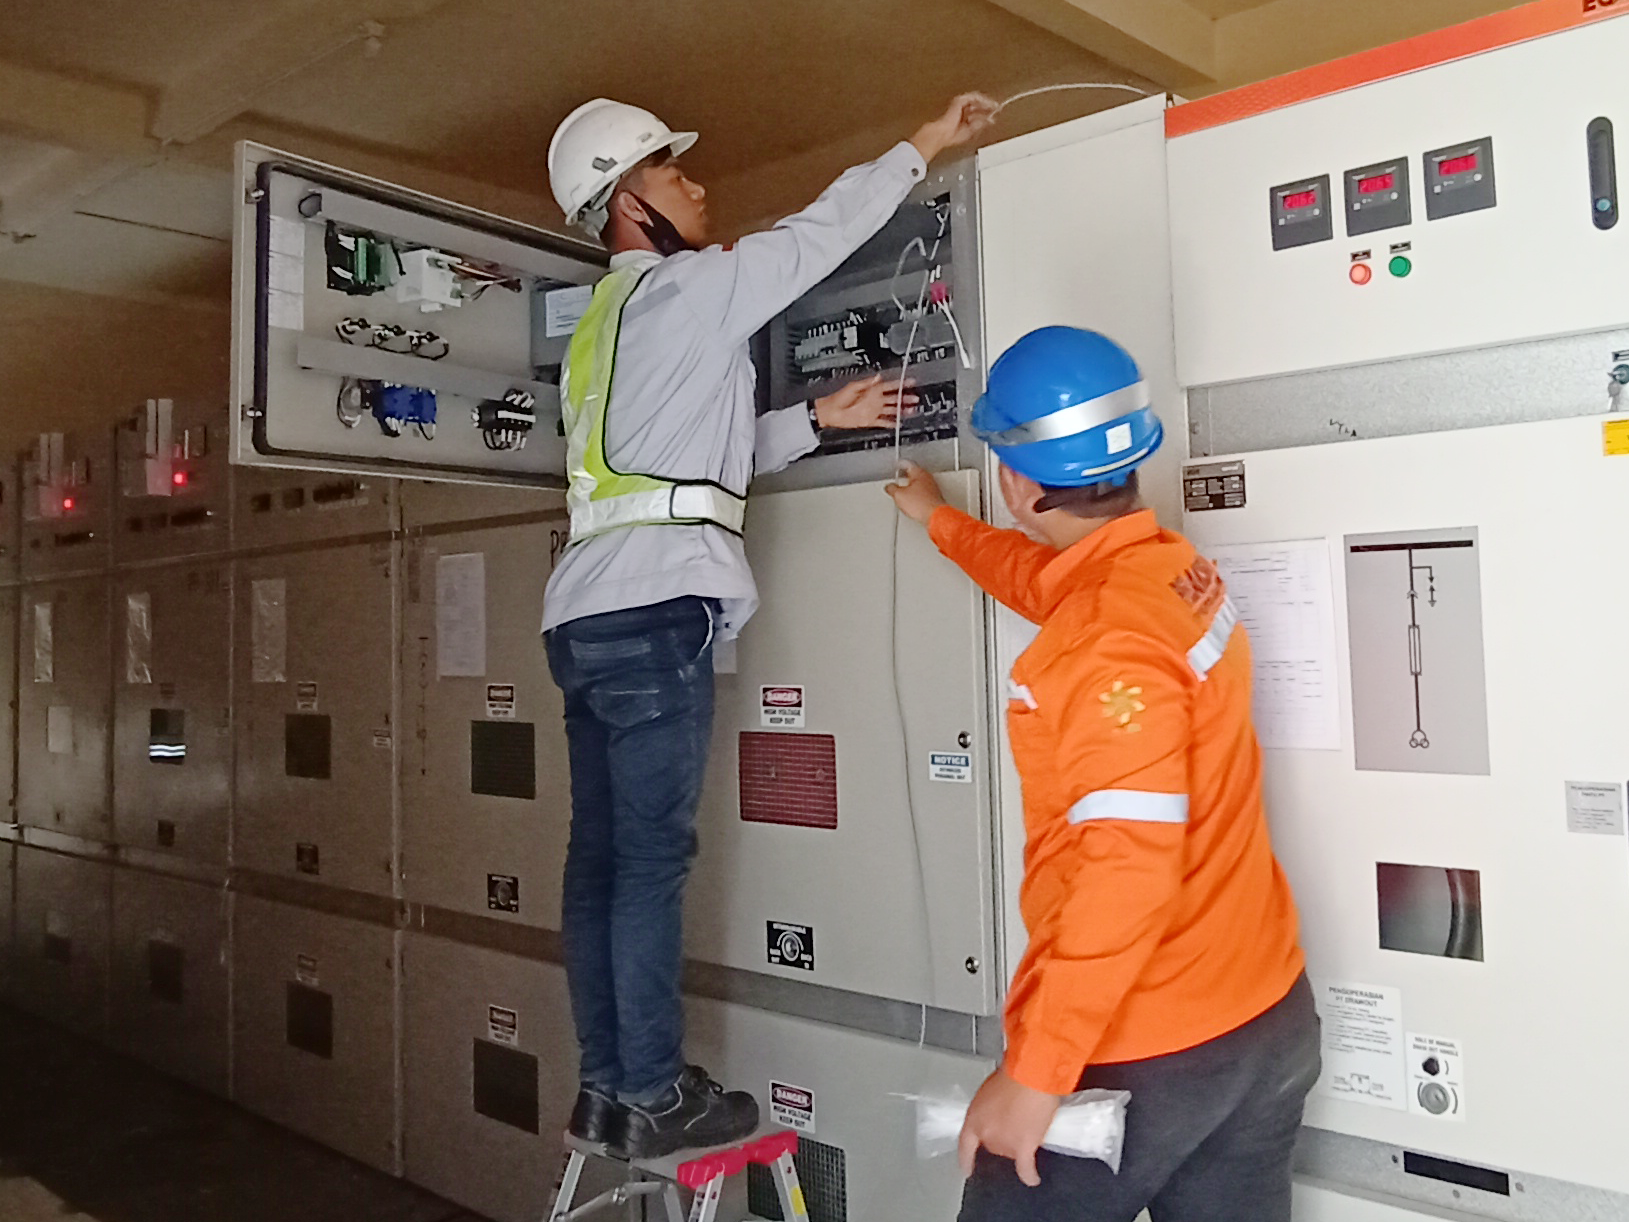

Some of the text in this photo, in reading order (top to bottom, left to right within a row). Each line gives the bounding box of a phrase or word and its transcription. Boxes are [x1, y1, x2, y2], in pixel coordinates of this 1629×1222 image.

[766, 691, 798, 702] DANGER
[934, 756, 966, 766] NOTICE
[776, 1088, 808, 1106] DANGER
[773, 1105, 811, 1122] HIGH VOLTAGE
[794, 1119, 806, 1129] OUT
